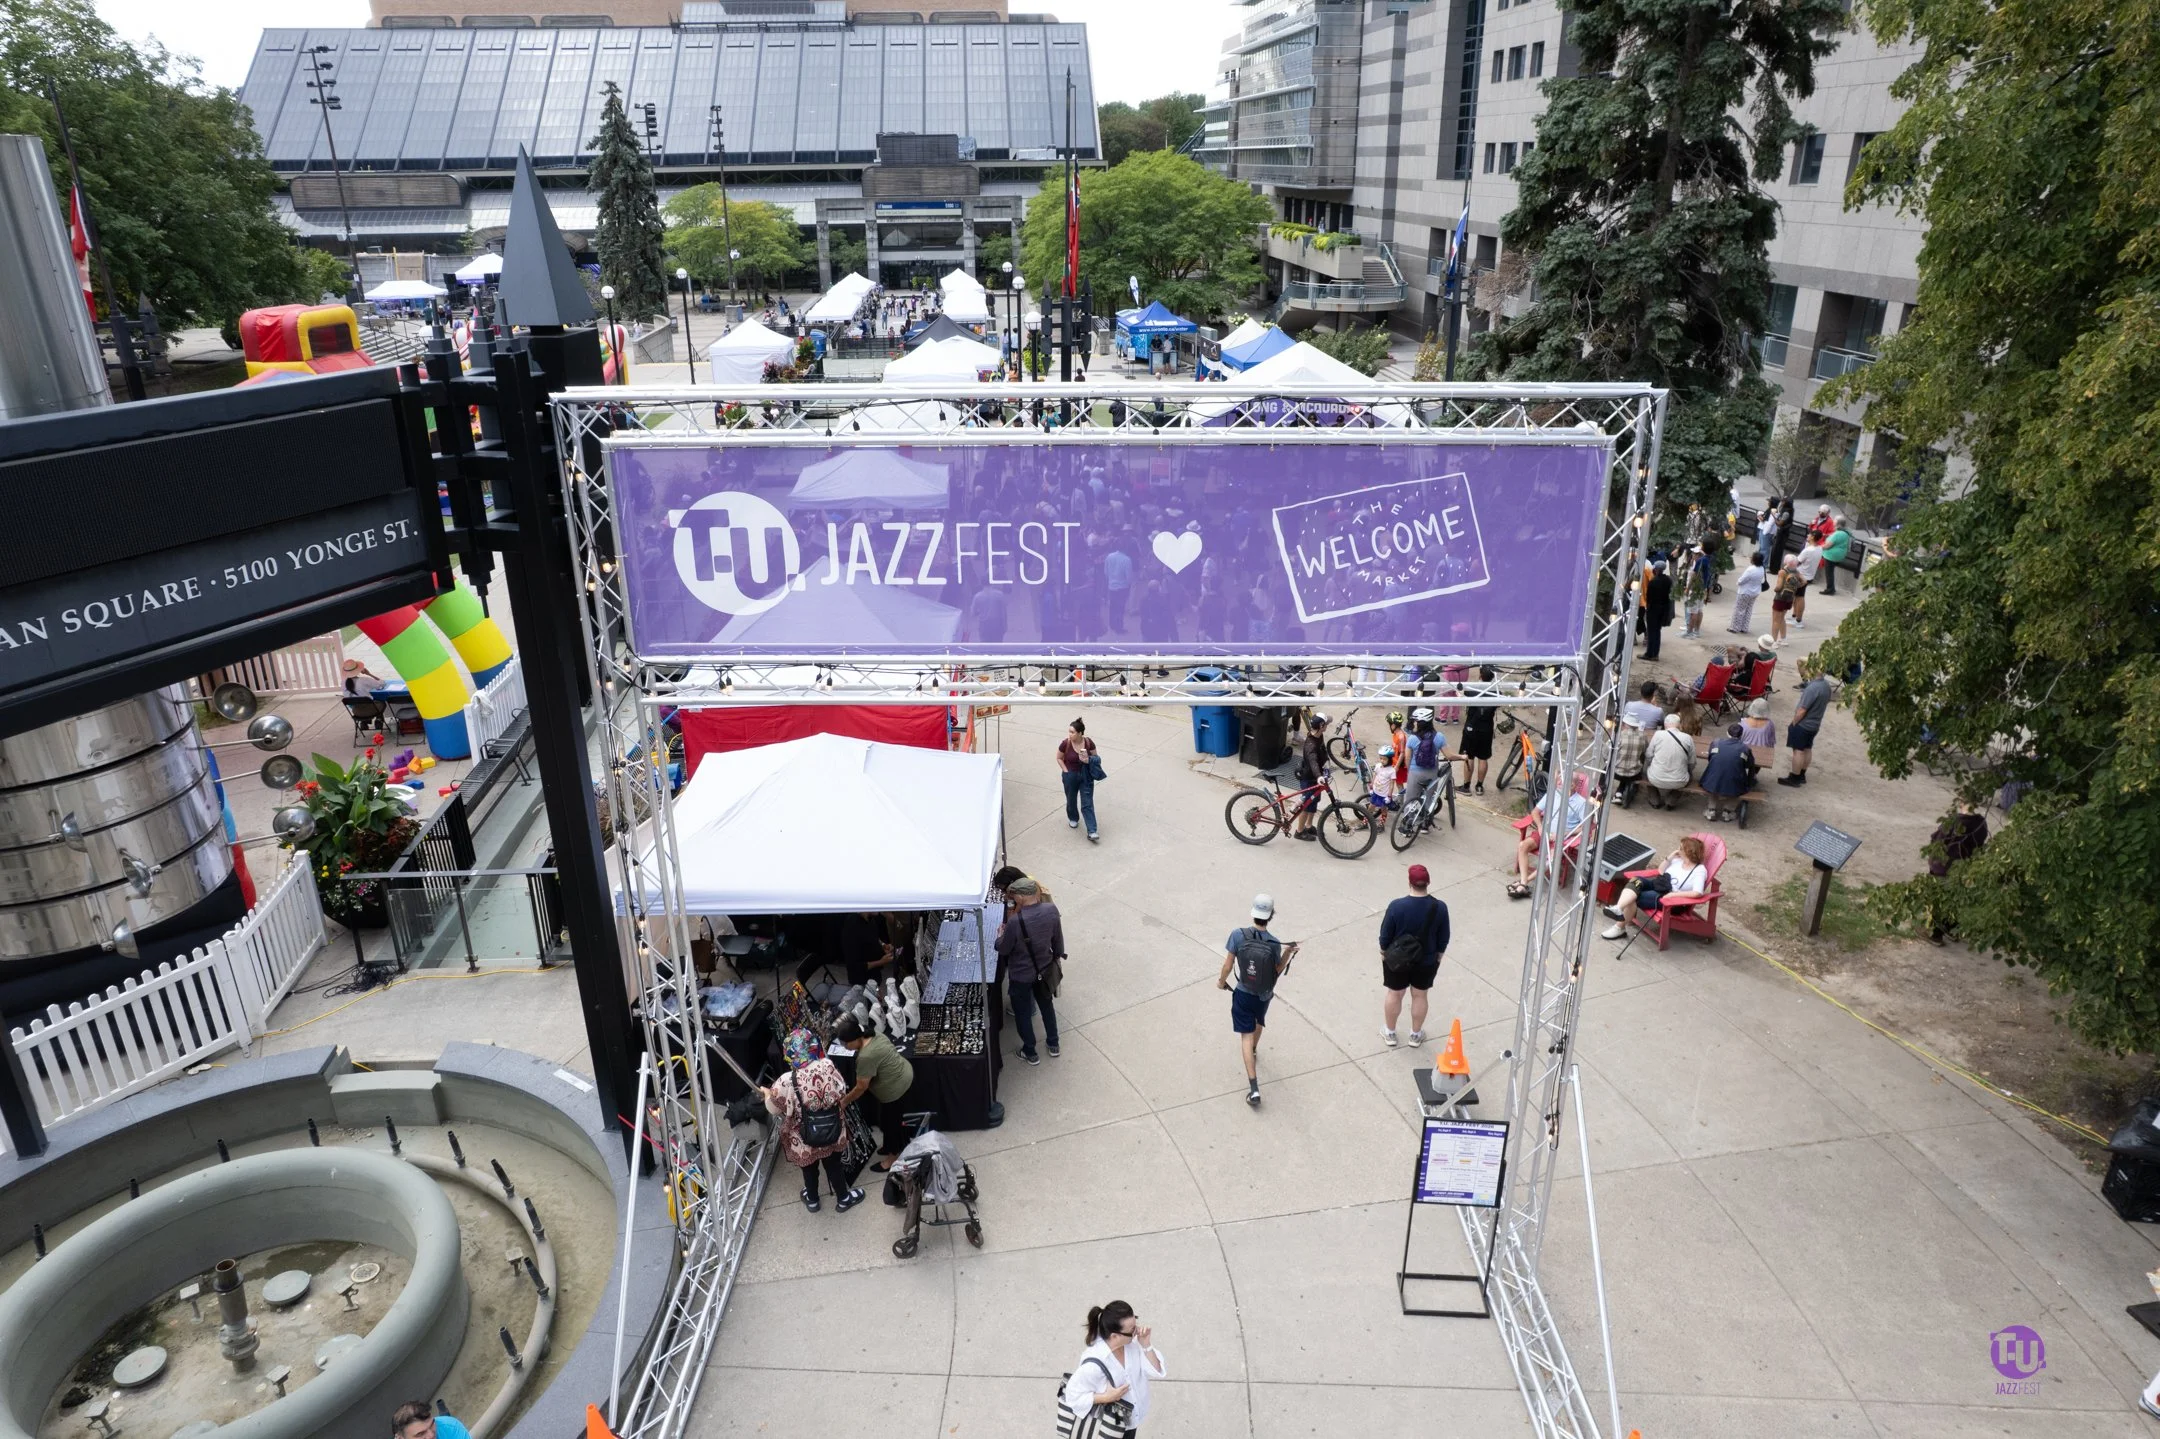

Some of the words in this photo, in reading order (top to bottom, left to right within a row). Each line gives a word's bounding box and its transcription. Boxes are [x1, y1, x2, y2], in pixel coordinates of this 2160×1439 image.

[1352, 501, 1403, 525] THE
[1296, 505, 1465, 578] WELCOME
[61, 576, 202, 634] SQUARE
[223, 556, 279, 590] 5100
[286, 528, 379, 570] YONGE
[382, 518, 419, 546] ST.
[1357, 555, 1426, 586] MARKET
